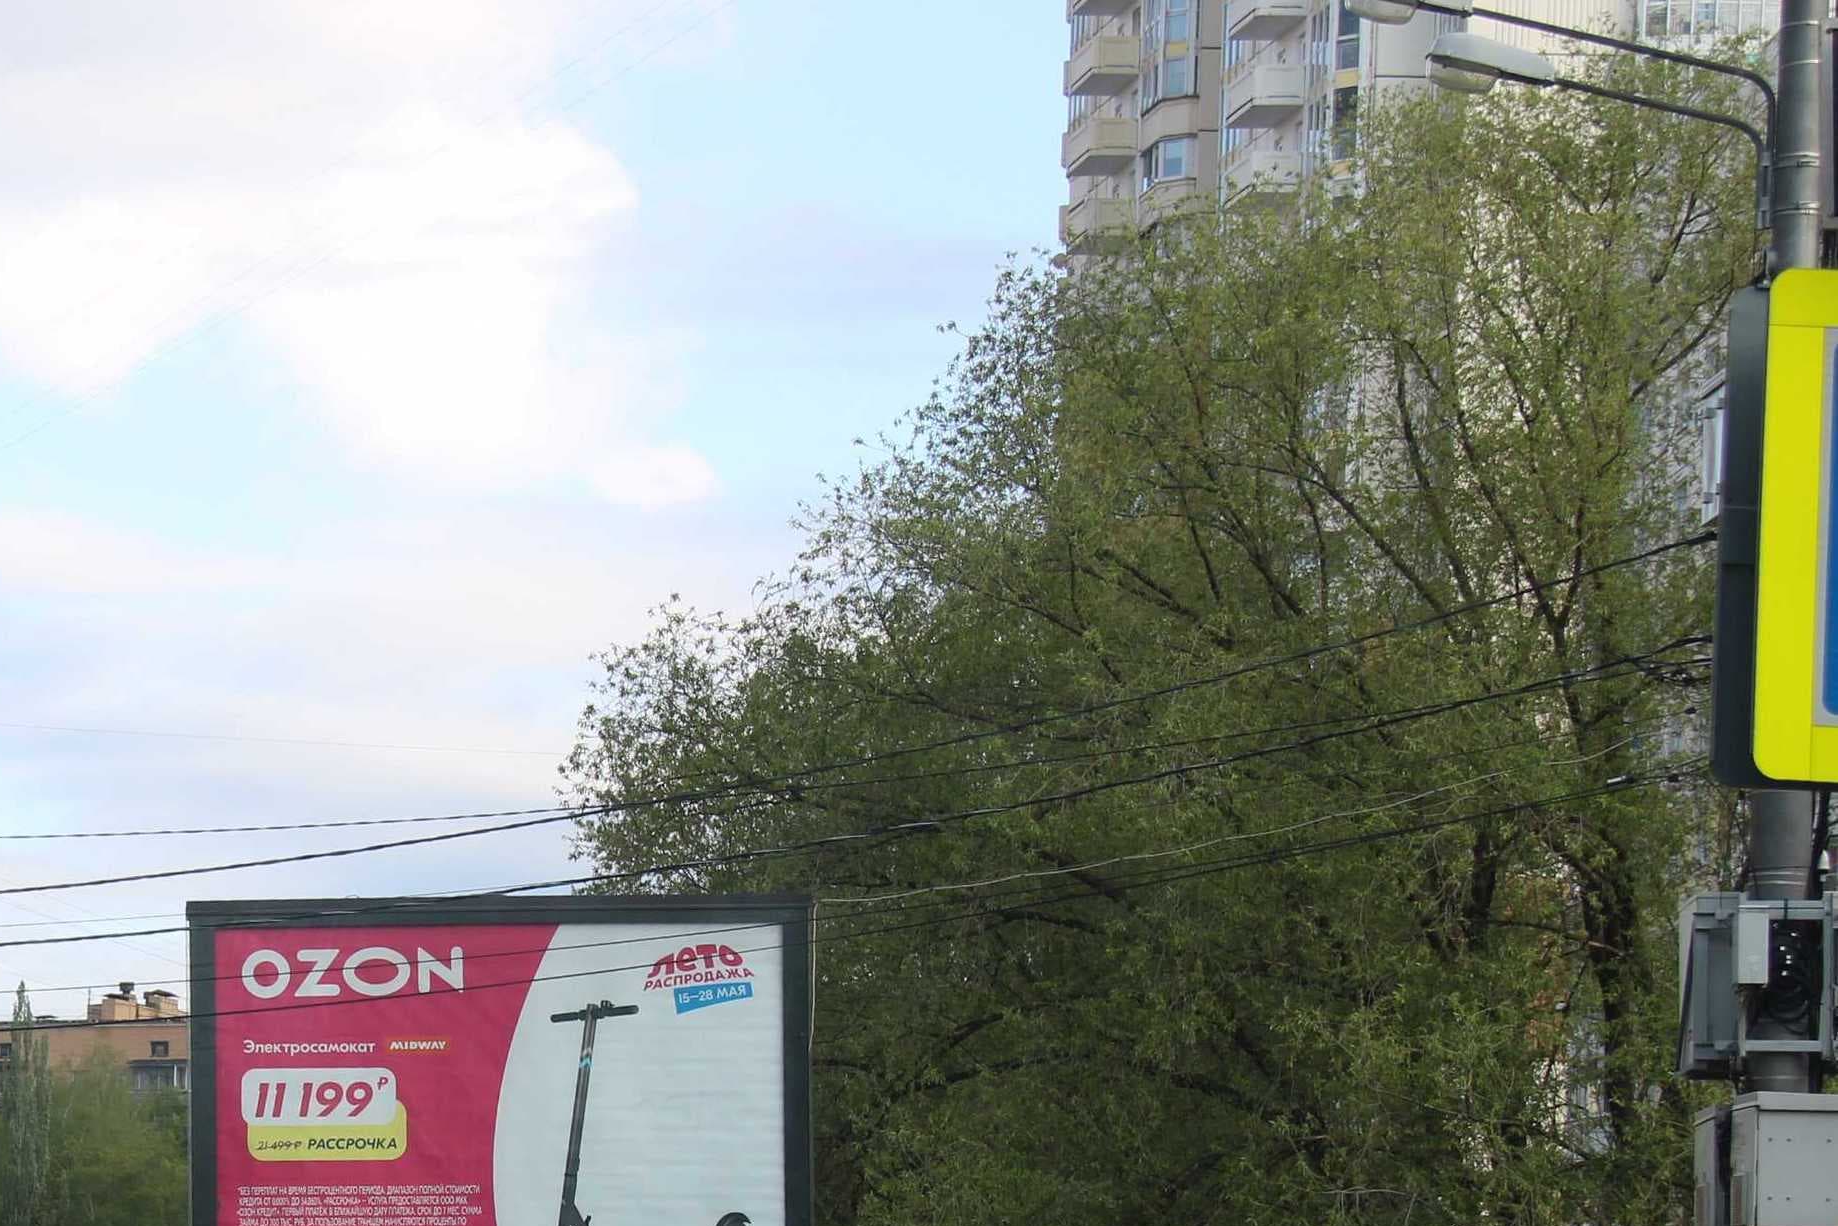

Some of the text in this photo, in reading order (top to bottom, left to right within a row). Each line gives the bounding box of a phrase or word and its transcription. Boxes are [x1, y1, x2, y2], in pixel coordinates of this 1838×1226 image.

[241, 946, 464, 998] OZON
[643, 968, 755, 991] РАСПРОДАЖА
[716, 984, 747, 998] МАЯ
[243, 1040, 375, 1056] Электросамокат
[389, 1041, 446, 1050] MIDWAY
[307, 1138, 398, 1151] РАССРОЧКА
